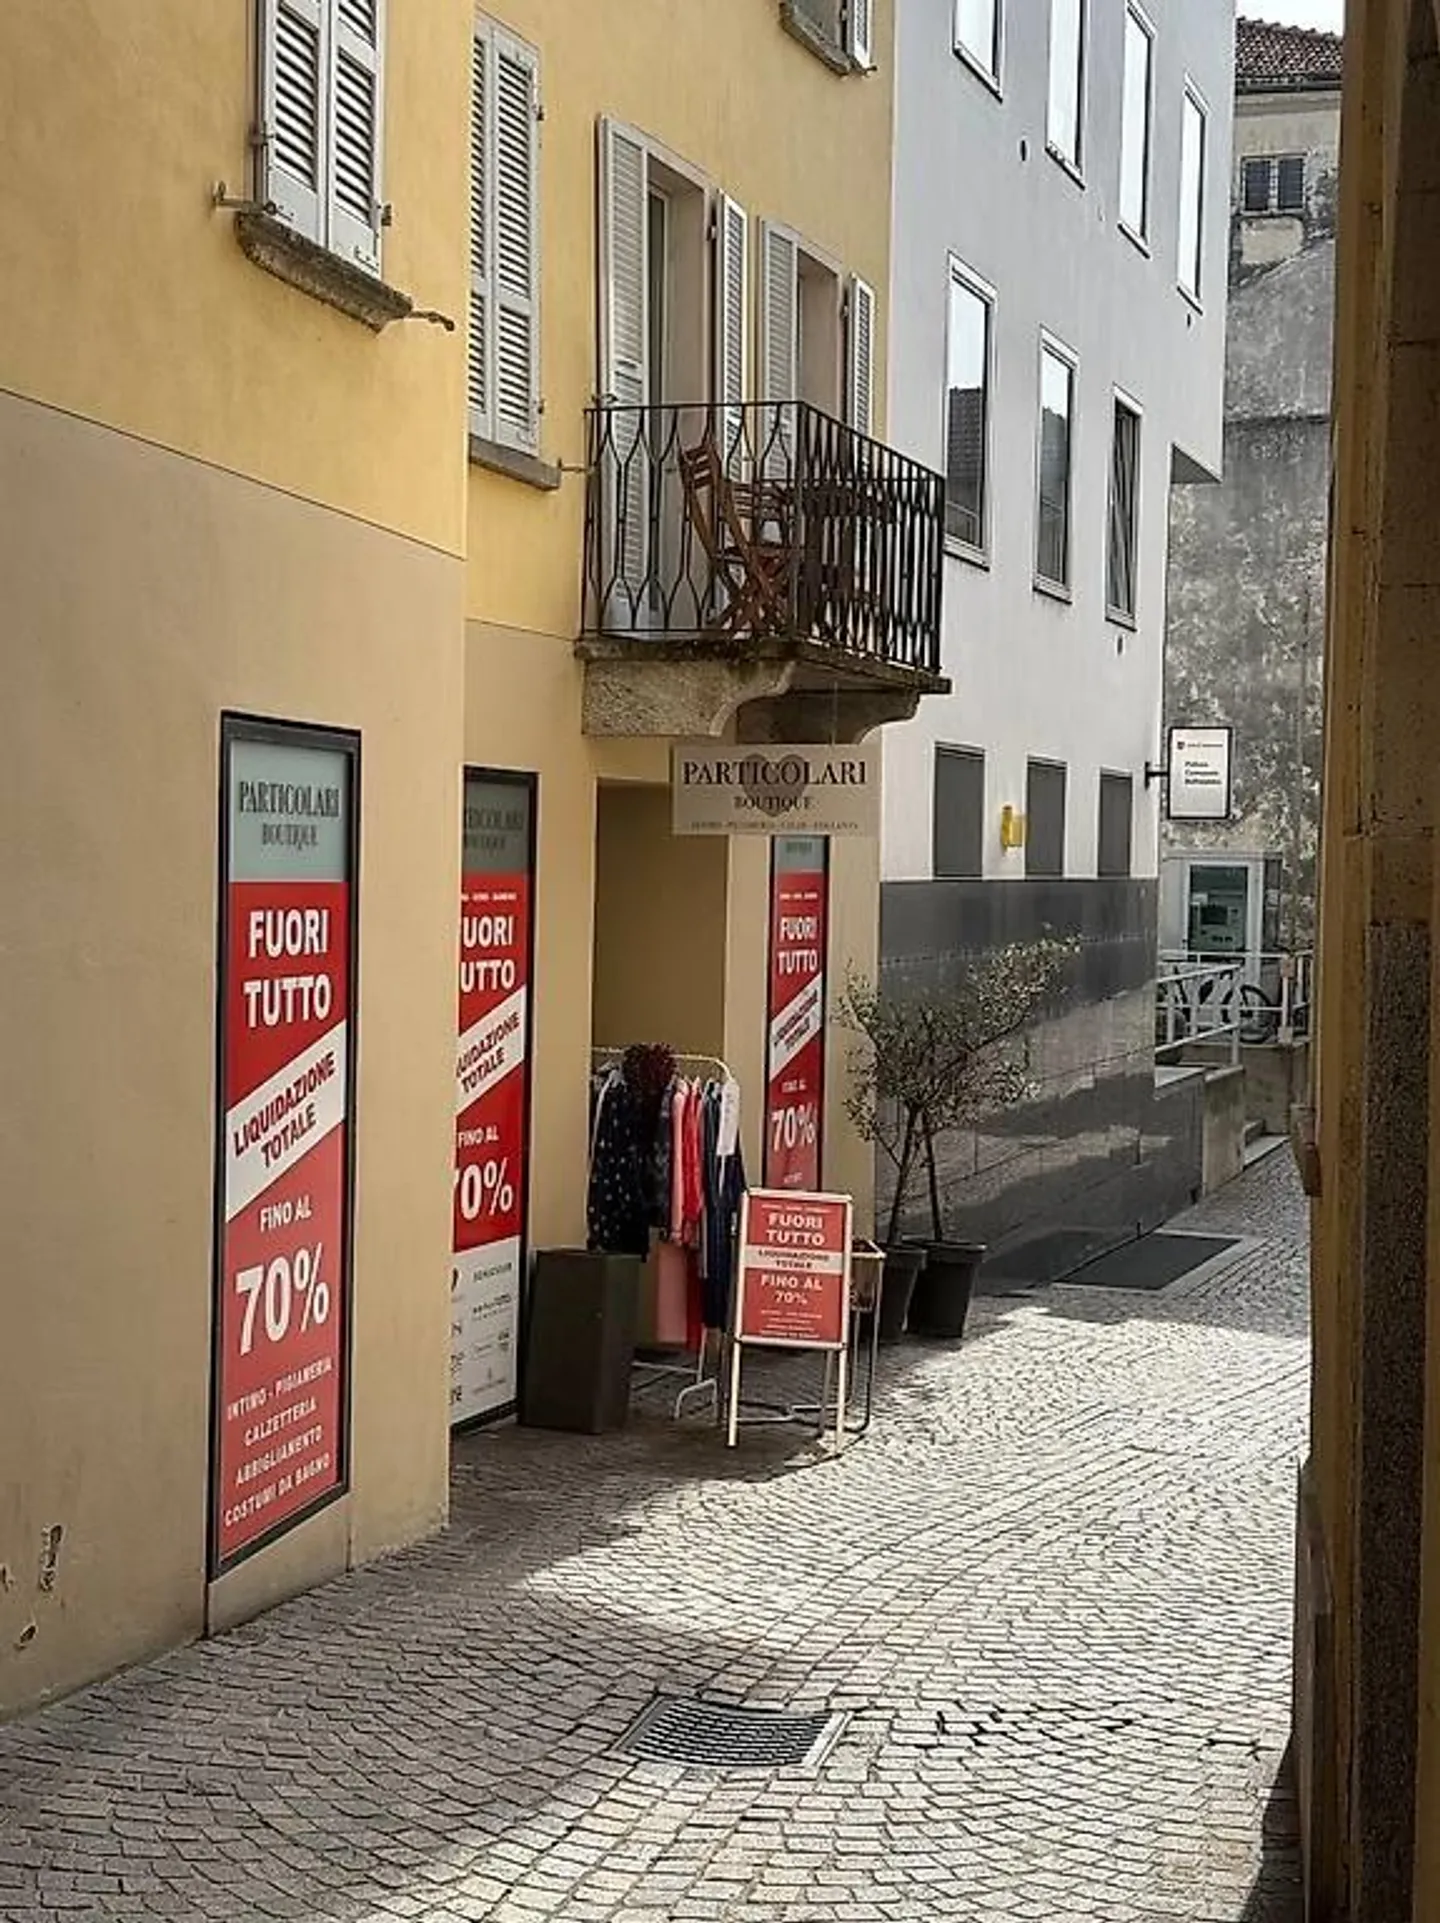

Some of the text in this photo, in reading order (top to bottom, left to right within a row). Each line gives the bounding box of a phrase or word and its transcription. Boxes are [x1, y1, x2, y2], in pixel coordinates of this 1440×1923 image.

[683, 761, 866, 785] PARTICOLARI
[239, 780, 340, 818] PARTICOLARI
[733, 796, 813, 812] BOUTIQUE
[248, 909, 329, 959] FUORI
[463, 915, 514, 948] UORI
[780, 916, 818, 943] FUORI
[460, 958, 516, 993] UTTO
[778, 949, 818, 976] TUTTO
[243, 973, 332, 1028] TUTTO
[460, 1046, 505, 1094] TOTALE
[233, 1050, 335, 1157] LIQUIDAZIONE
[260, 1103, 317, 1169] TOTALE
[458, 1123, 500, 1149] FINO AL
[771, 1101, 818, 1153] 70%
[453, 1156, 514, 1221] 0%
[260, 1194, 313, 1234] FINO AL
[768, 1212, 823, 1229] FUORI
[765, 1229, 825, 1247] TUTTO
[236, 1241, 331, 1357] 70%
[760, 1274, 824, 1291] FINO AL
[773, 1290, 809, 1305] 70%
[227, 1387, 268, 1421] INTIMO
[244, 1396, 317, 1447] CALZETTERIA
[235, 1424, 323, 1487] ABBIGLIAMENTO
[224, 1452, 331, 1527] COSTUMI DA BAGNO
